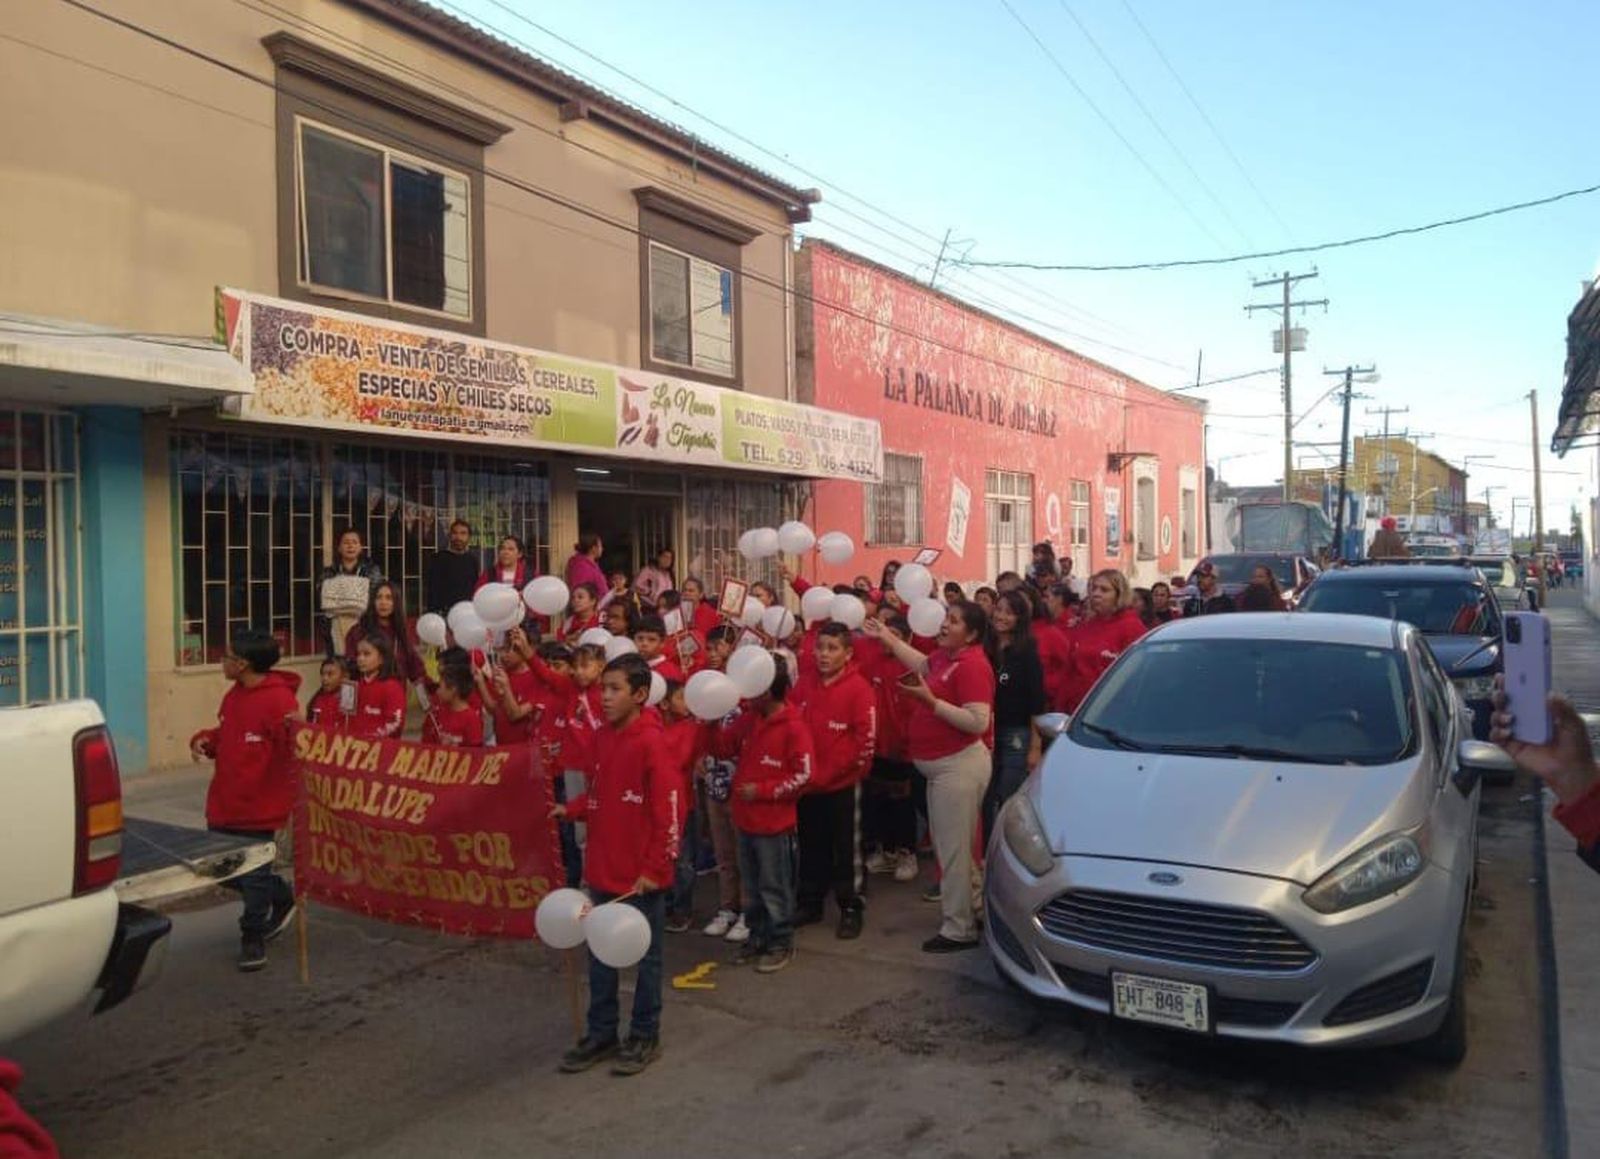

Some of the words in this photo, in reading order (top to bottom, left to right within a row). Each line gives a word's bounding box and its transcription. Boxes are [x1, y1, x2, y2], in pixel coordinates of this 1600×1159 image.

[280, 325, 361, 361] COMPRA
[378, 343, 432, 372] VENTA
[436, 353, 458, 376] DE
[460, 356, 530, 388] SEMILLAS,
[532, 370, 599, 400] CEREALES,
[358, 372, 438, 402] ESPECIAS
[441, 382, 451, 403] Y
[456, 385, 506, 411] CHILES
[509, 393, 552, 416] SECOS
[884, 367, 907, 403] LA
[913, 372, 983, 422] PALANCA
[988, 392, 1005, 427] DE
[295, 728, 382, 771] SANTA
[388, 747, 472, 785] MARIA
[471, 752, 511, 785] DE
[450, 831, 515, 872] POR
